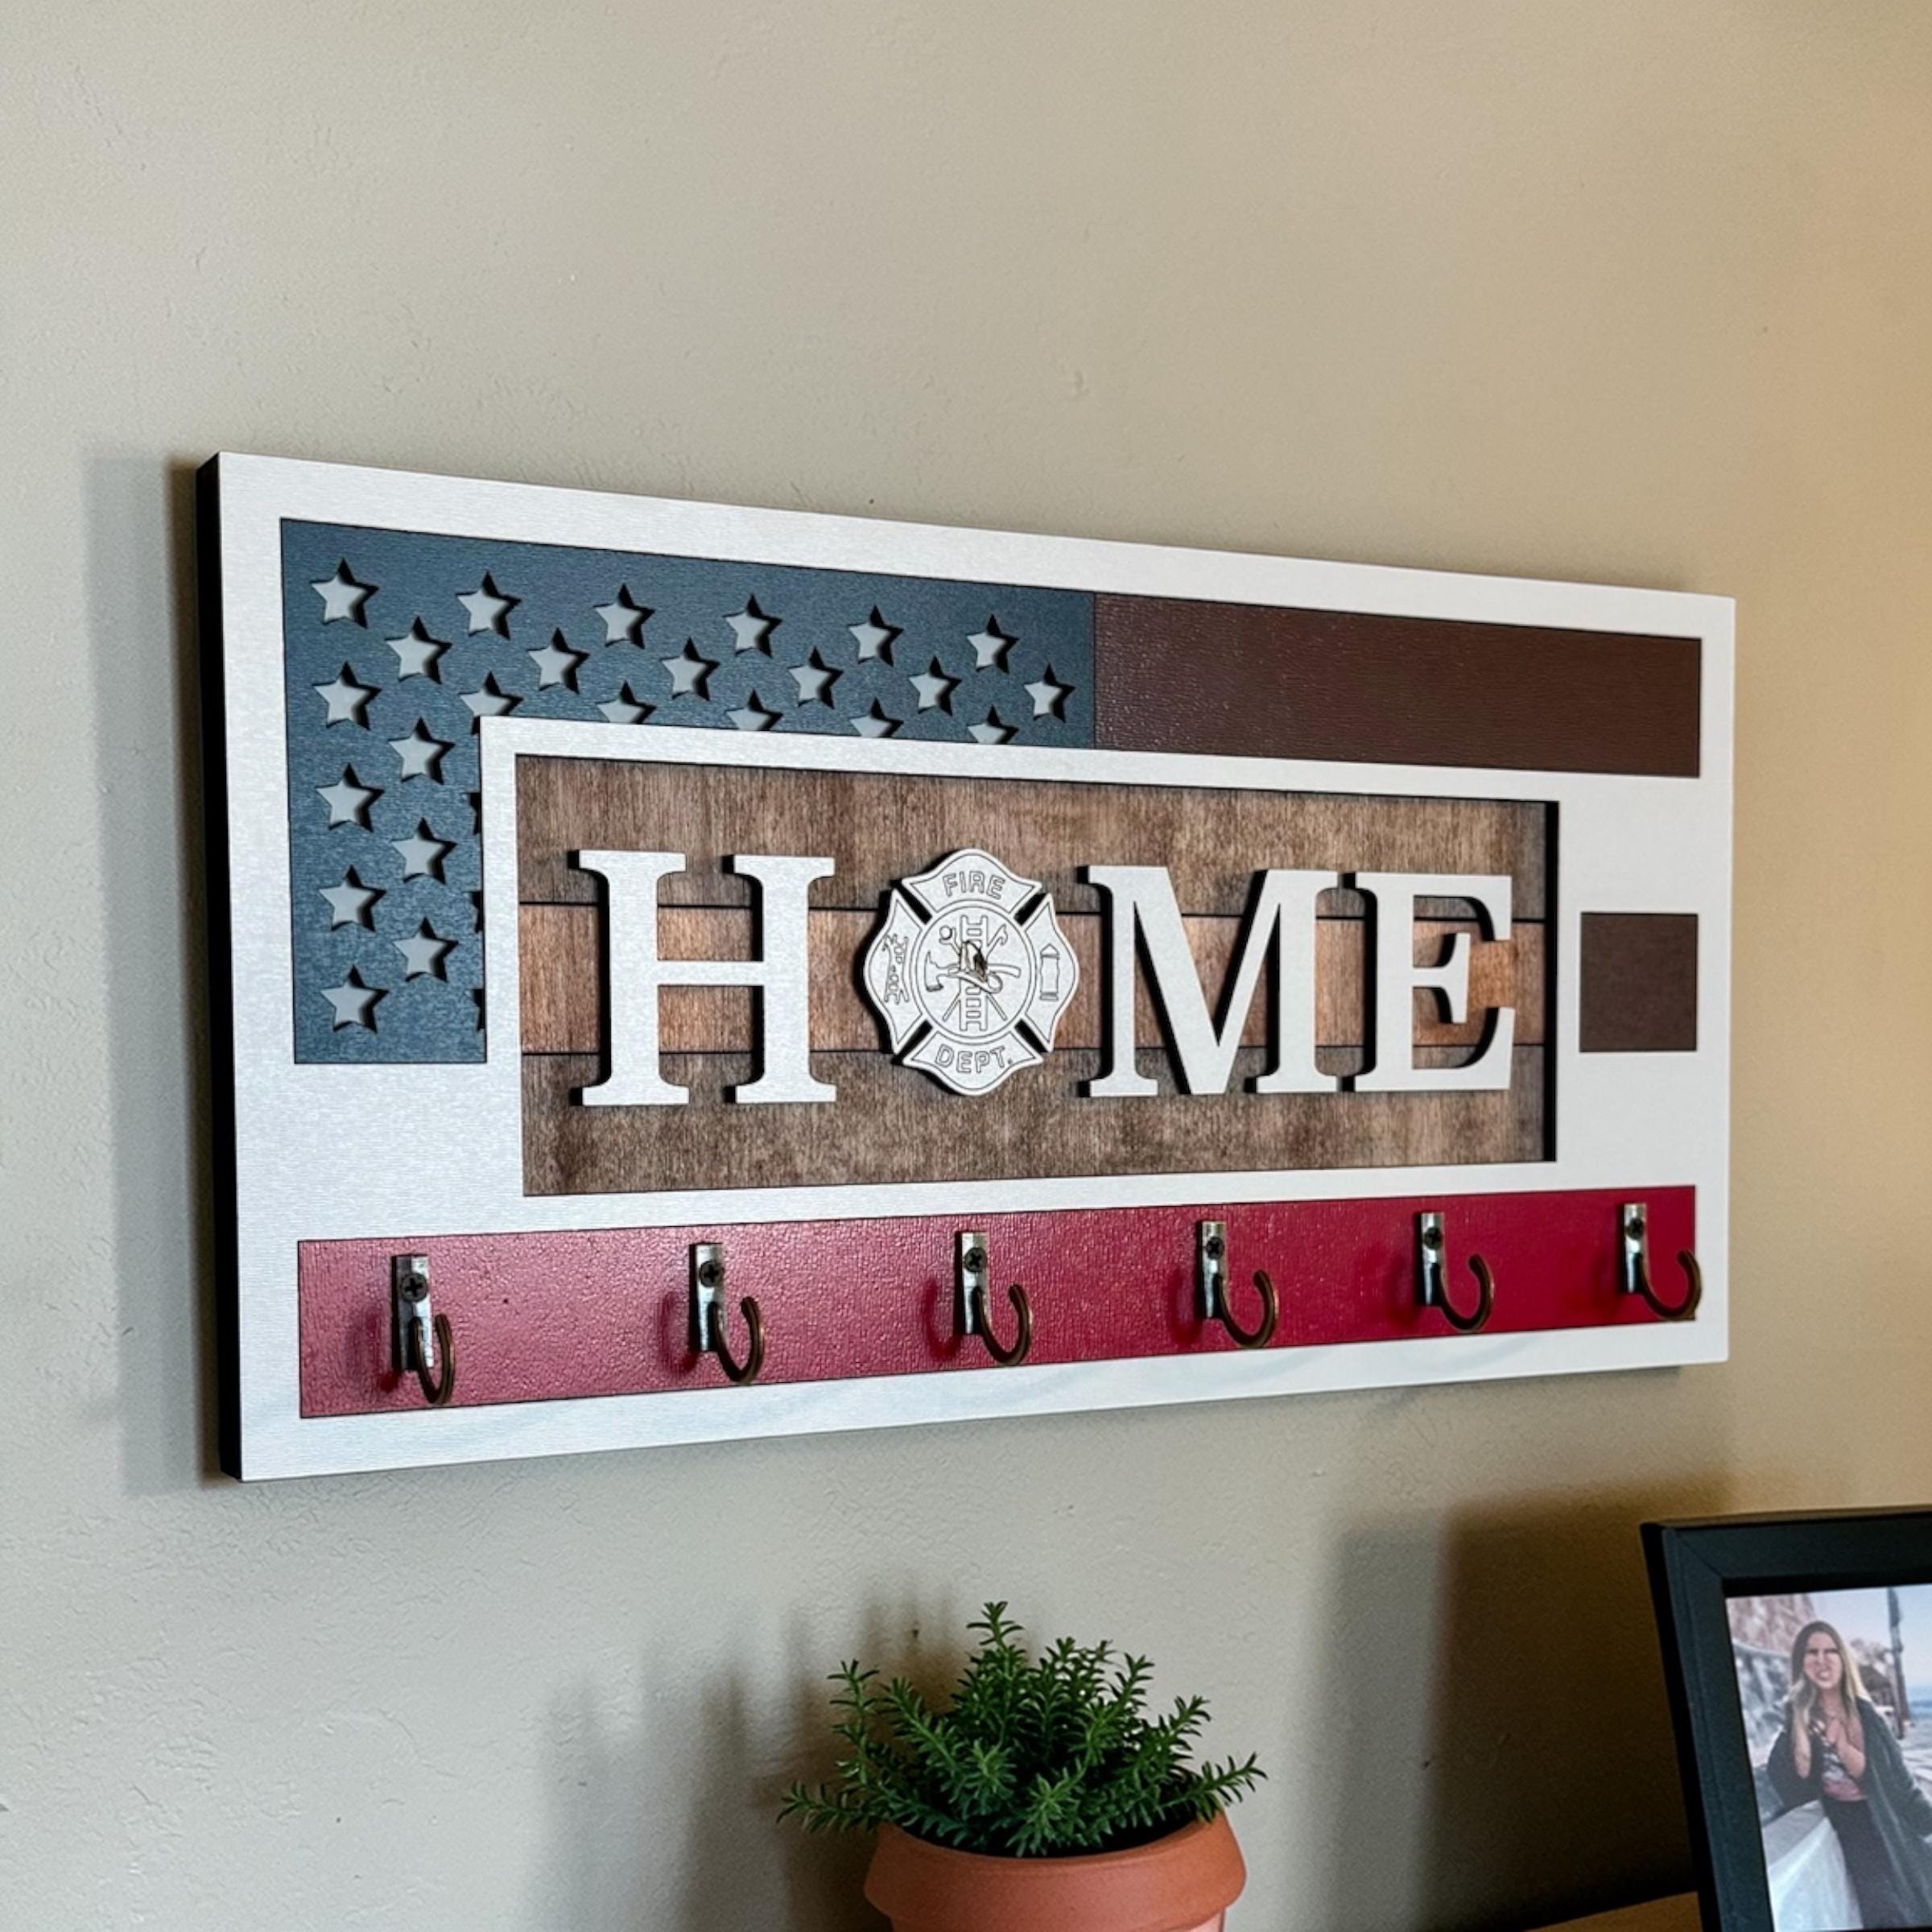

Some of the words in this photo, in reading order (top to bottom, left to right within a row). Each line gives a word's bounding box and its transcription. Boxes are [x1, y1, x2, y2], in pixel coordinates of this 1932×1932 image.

[942, 870, 1006, 900] FIRE
[576, 848, 1515, 1107] HME
[934, 1044, 1013, 1074] DEPT.
